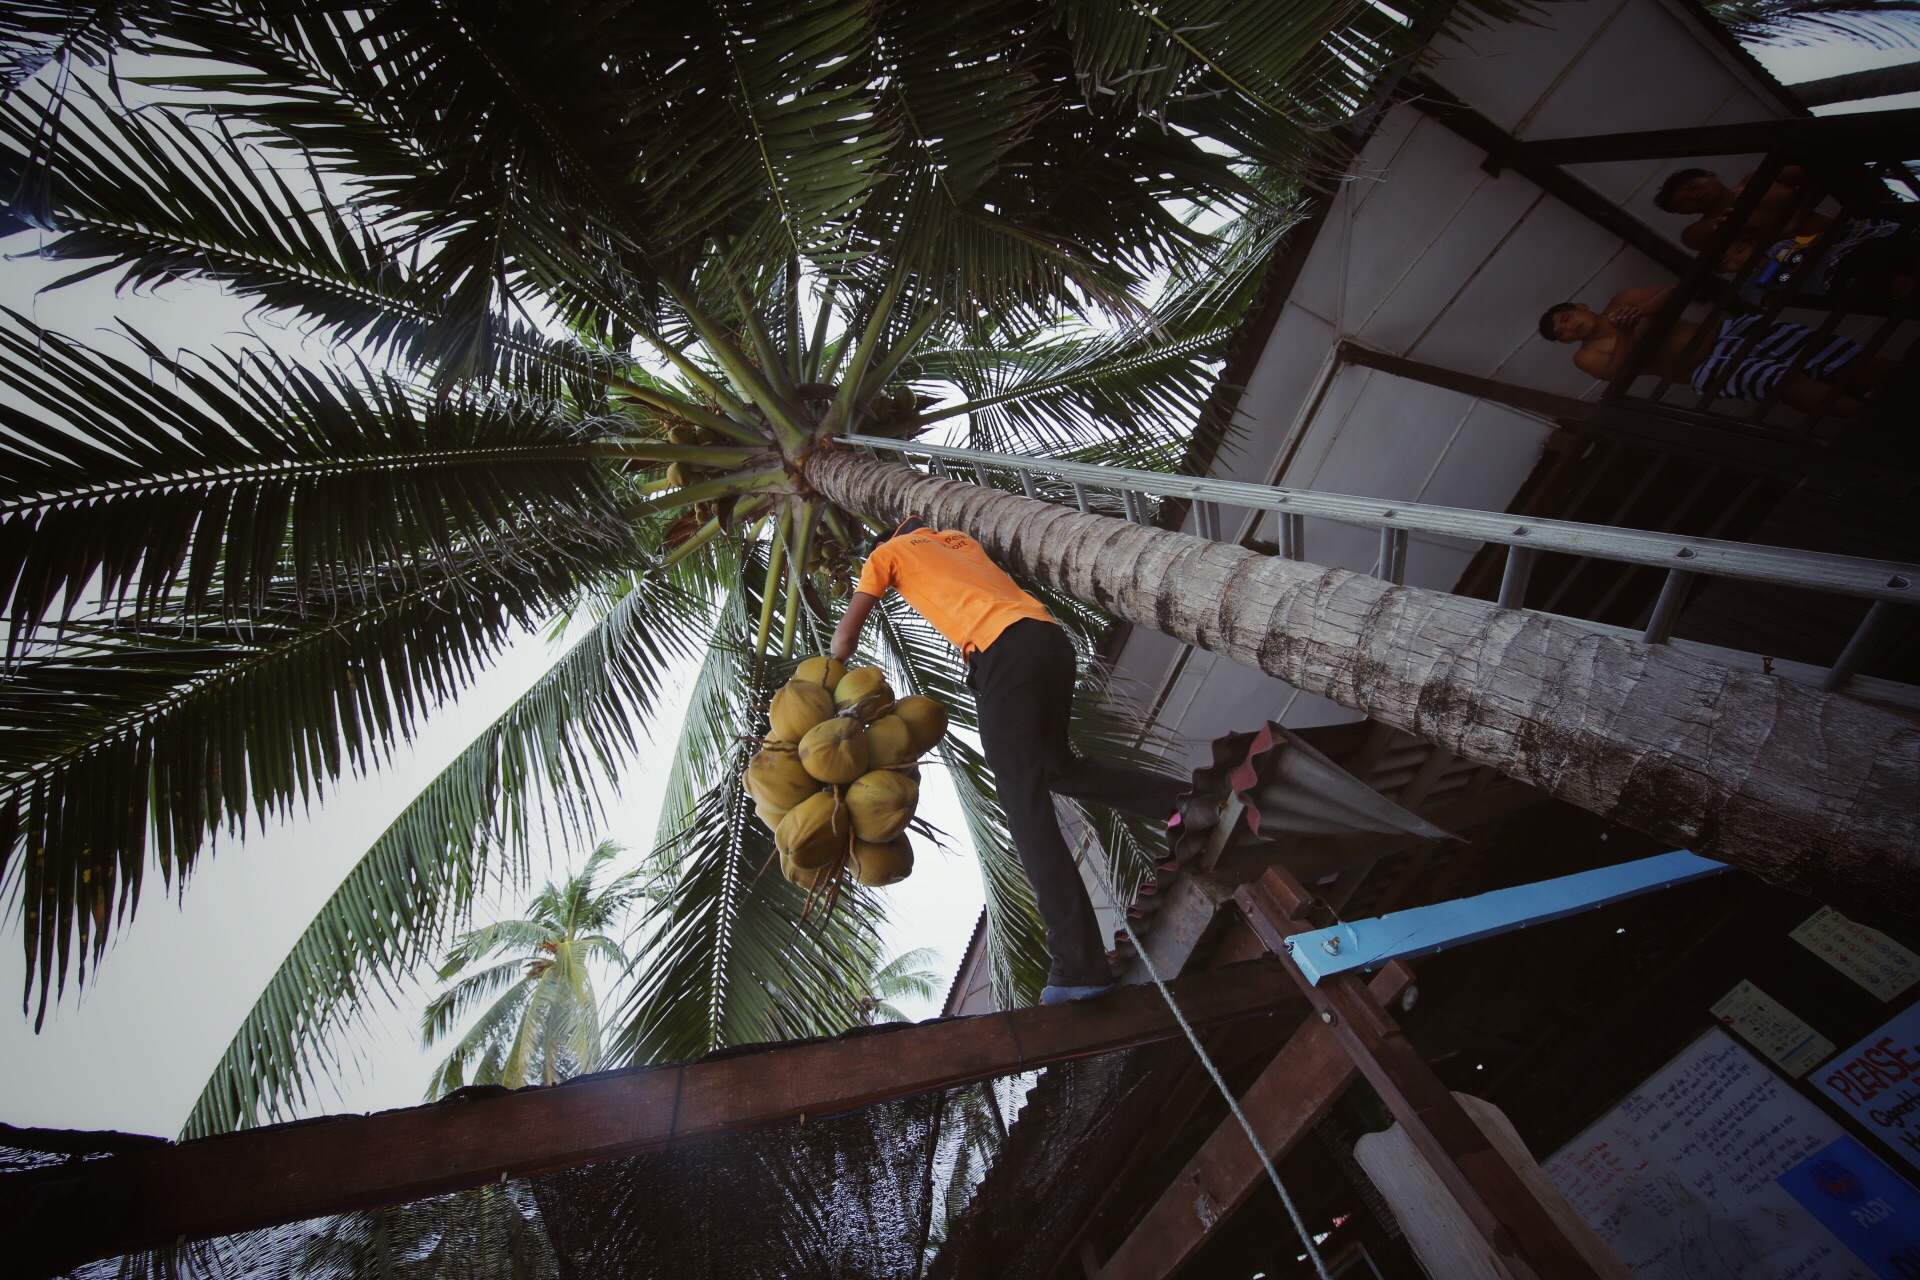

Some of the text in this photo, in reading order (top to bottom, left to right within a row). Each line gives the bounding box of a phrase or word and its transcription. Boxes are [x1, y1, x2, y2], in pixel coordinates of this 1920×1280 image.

[1800, 908, 1830, 932] GREEN FINS
[1826, 1037, 1920, 1106] PLEASE
[1849, 1196, 1896, 1228] PADI
